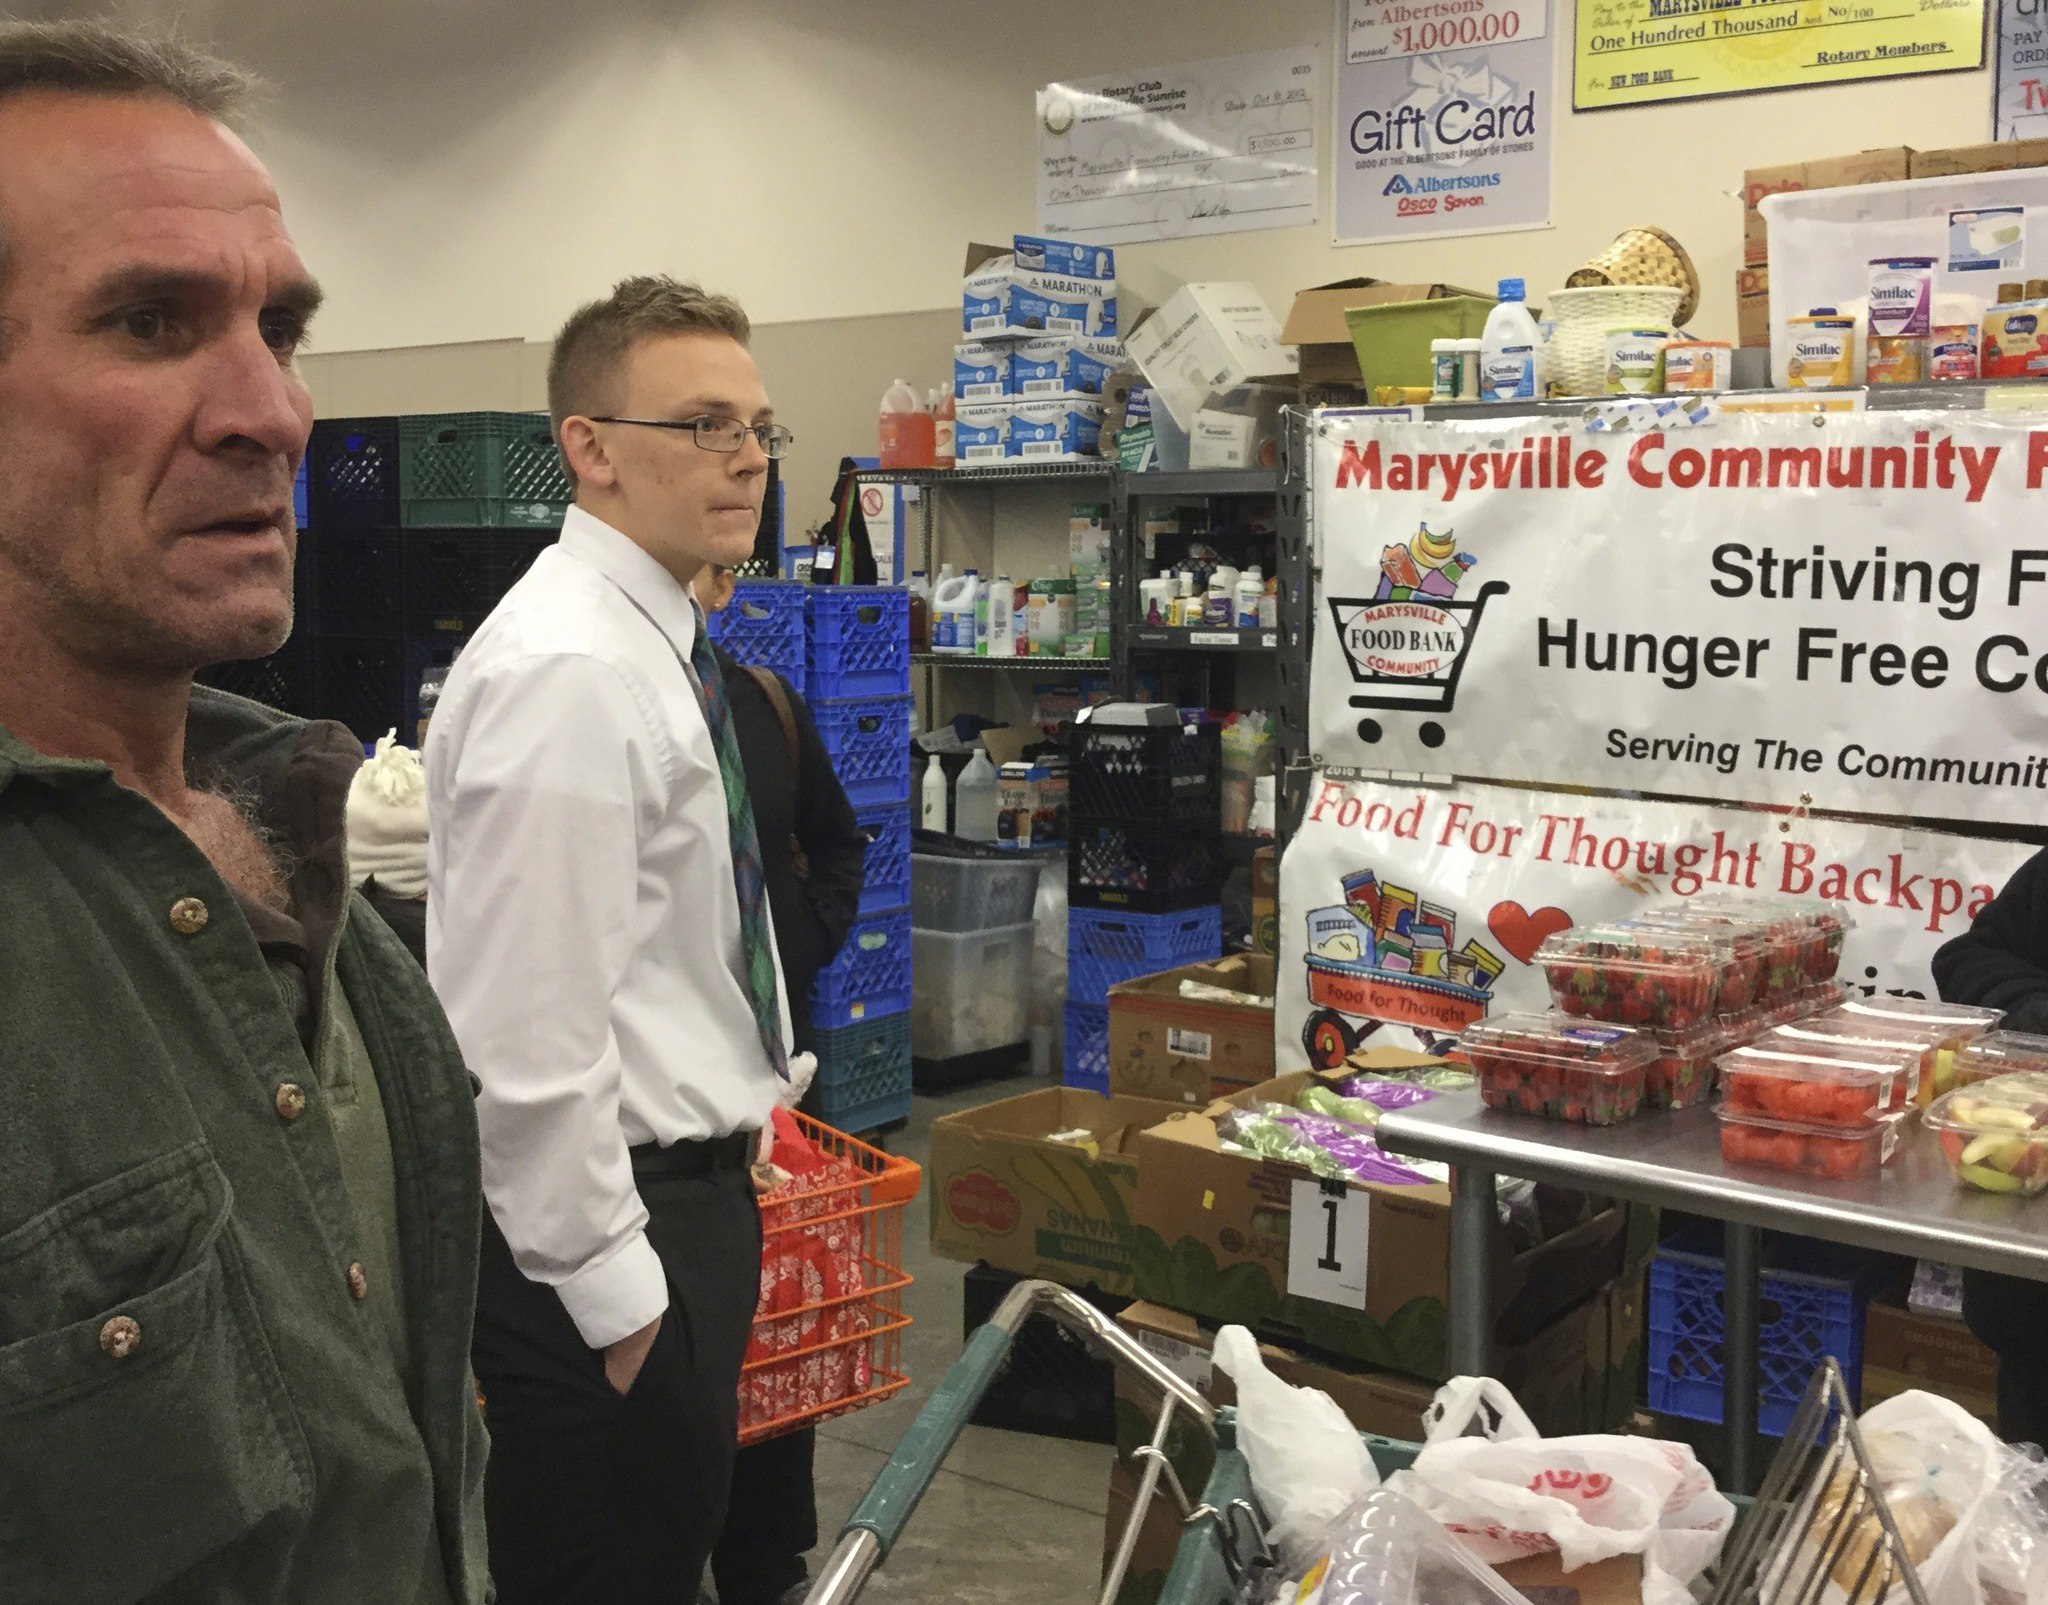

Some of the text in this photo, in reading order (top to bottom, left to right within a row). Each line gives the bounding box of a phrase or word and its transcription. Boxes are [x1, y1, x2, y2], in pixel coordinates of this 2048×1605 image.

[1381, 0, 1484, 25] Albertsons
[1393, 11, 1519, 54] $1,000.00
[1590, 35, 1625, 51] One
[1631, 21, 1706, 46] Hundred
[1713, 10, 1798, 35] Thousand
[2013, 30, 2042, 46] PAY
[1817, 40, 1948, 64] Rotary Members
[2013, 48, 2048, 63] ORD
[1653, 69, 1674, 81] BANK
[1102, 81, 1162, 98] Rotary Club
[1147, 89, 1186, 102] Sunrise
[1350, 90, 1536, 154] Gift Card
[1379, 158, 1388, 167] AT
[1390, 157, 1404, 167] THE
[1490, 147, 1499, 156] OF
[1503, 142, 1534, 153] STORES
[1415, 172, 1501, 194] Albertsons
[1398, 197, 1438, 213] Osco
[1042, 279, 1102, 297] MARATHON
[1871, 286, 1916, 300] Similac
[1027, 340, 1067, 349] MARATHON
[1796, 343, 1841, 356] Similac
[1614, 350, 1656, 362] Similac
[969, 408, 1008, 416] MARATHON
[1026, 403, 1066, 412] MARATHON
[1335, 436, 1608, 502] Marysville
[1627, 431, 2001, 503] Community
[1710, 542, 2048, 621] Striving F
[1364, 605, 1447, 626] MARYSVILLE
[1351, 629, 1456, 653] FOOD BANK
[1537, 617, 1770, 690] Hunger
[1796, 626, 1949, 689] Free
[1366, 655, 1440, 676] COMMUNITY
[1605, 728, 2048, 791] Serving The Communit
[1308, 780, 1428, 841] Food
[1436, 801, 1522, 858] For
[1535, 814, 1762, 897] Thought
[1327, 983, 1466, 1024] Food for Thought
[1318, 1200, 1341, 1272] 1
